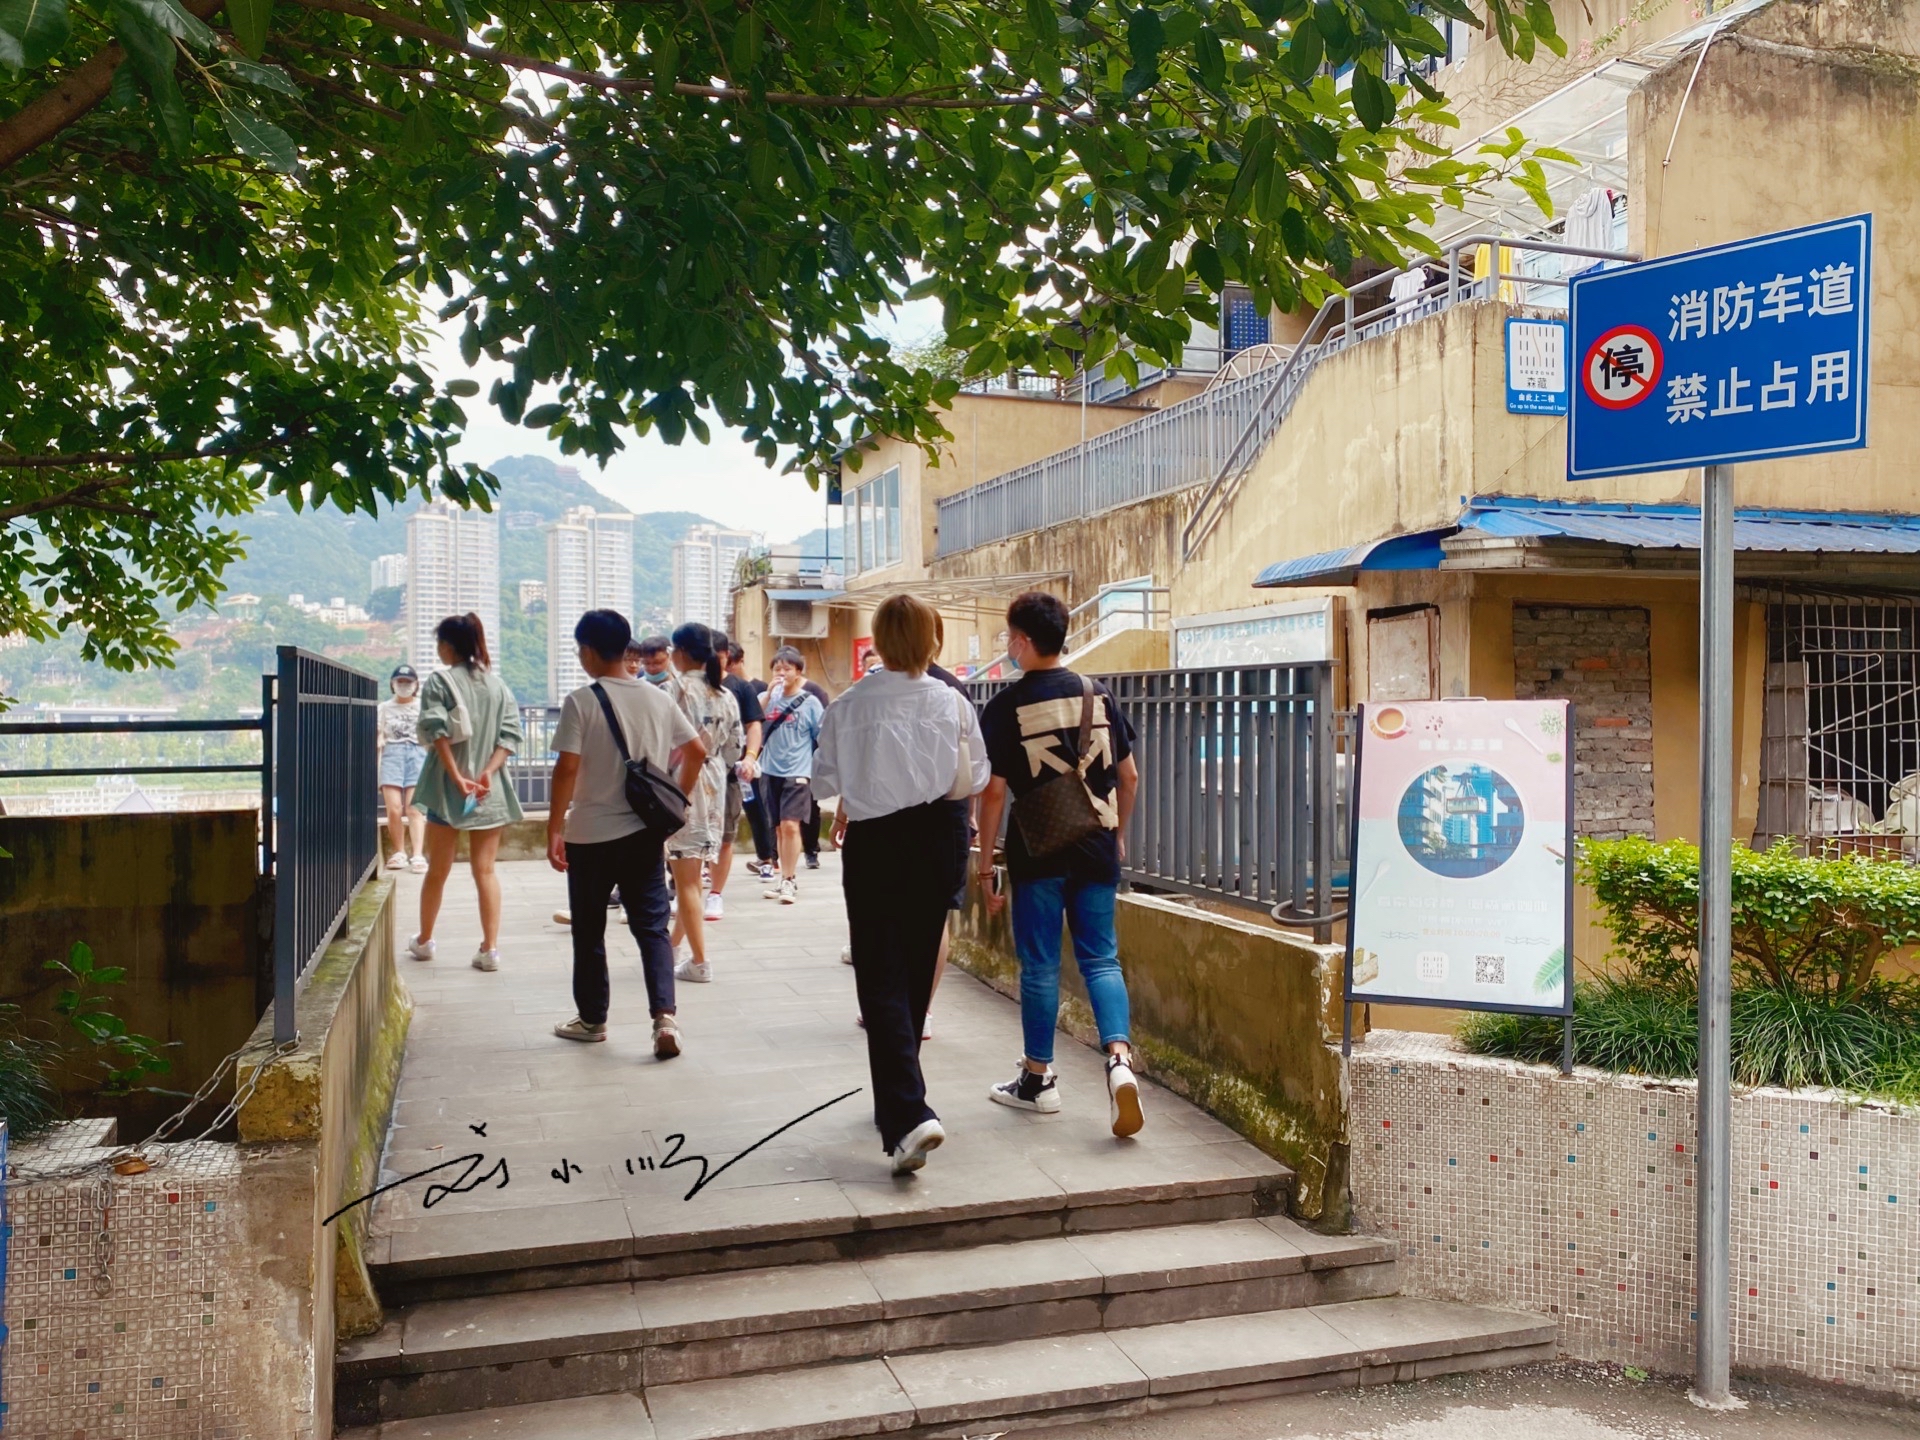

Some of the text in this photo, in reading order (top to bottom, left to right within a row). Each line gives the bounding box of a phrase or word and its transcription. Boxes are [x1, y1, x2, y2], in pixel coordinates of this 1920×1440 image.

[1668, 262, 1854, 342] 消防车道
[1600, 345, 1644, 390] 停
[1666, 350, 1851, 425] 禁止占用
